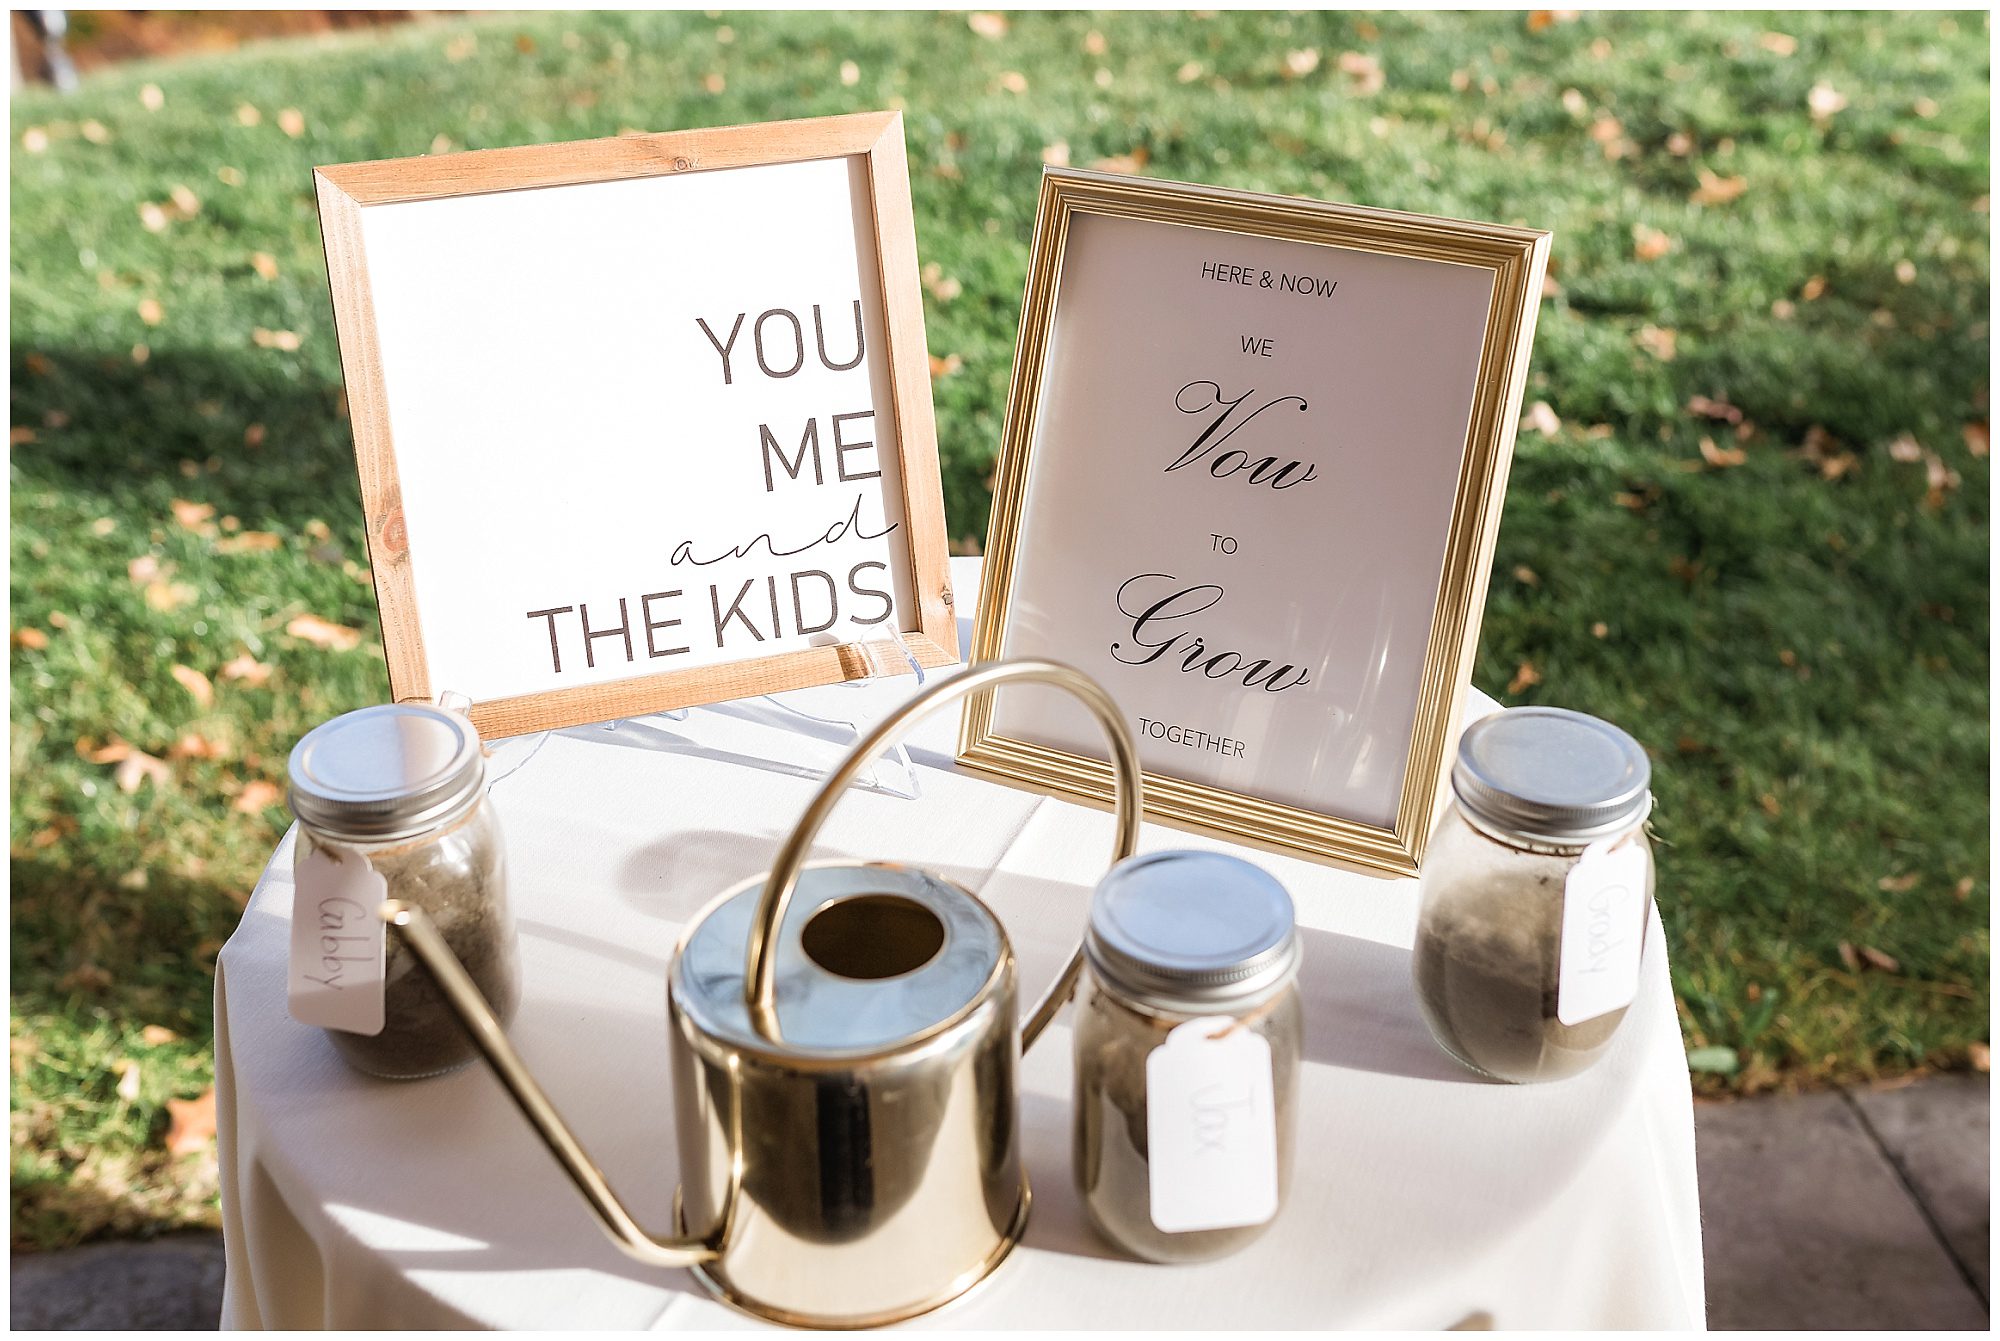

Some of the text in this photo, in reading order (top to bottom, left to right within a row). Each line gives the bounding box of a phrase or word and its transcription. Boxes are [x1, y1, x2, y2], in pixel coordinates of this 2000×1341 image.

[1201, 261, 1337, 298] HERE & NOW
[695, 300, 865, 385] YOU
[1240, 335, 1274, 357] WE
[759, 410, 881, 492] ME
[1164, 380, 1318, 489] Vow
[671, 493, 899, 566] and
[1210, 533, 1238, 554] TO
[527, 561, 893, 673] THE KIDS
[1110, 573, 1310, 692] Grow
[1138, 717, 1246, 758] TOGETHER
[303, 896, 375, 991] Gabby
[1578, 883, 1630, 975] Grady
[1189, 1082, 1256, 1156] Jax
